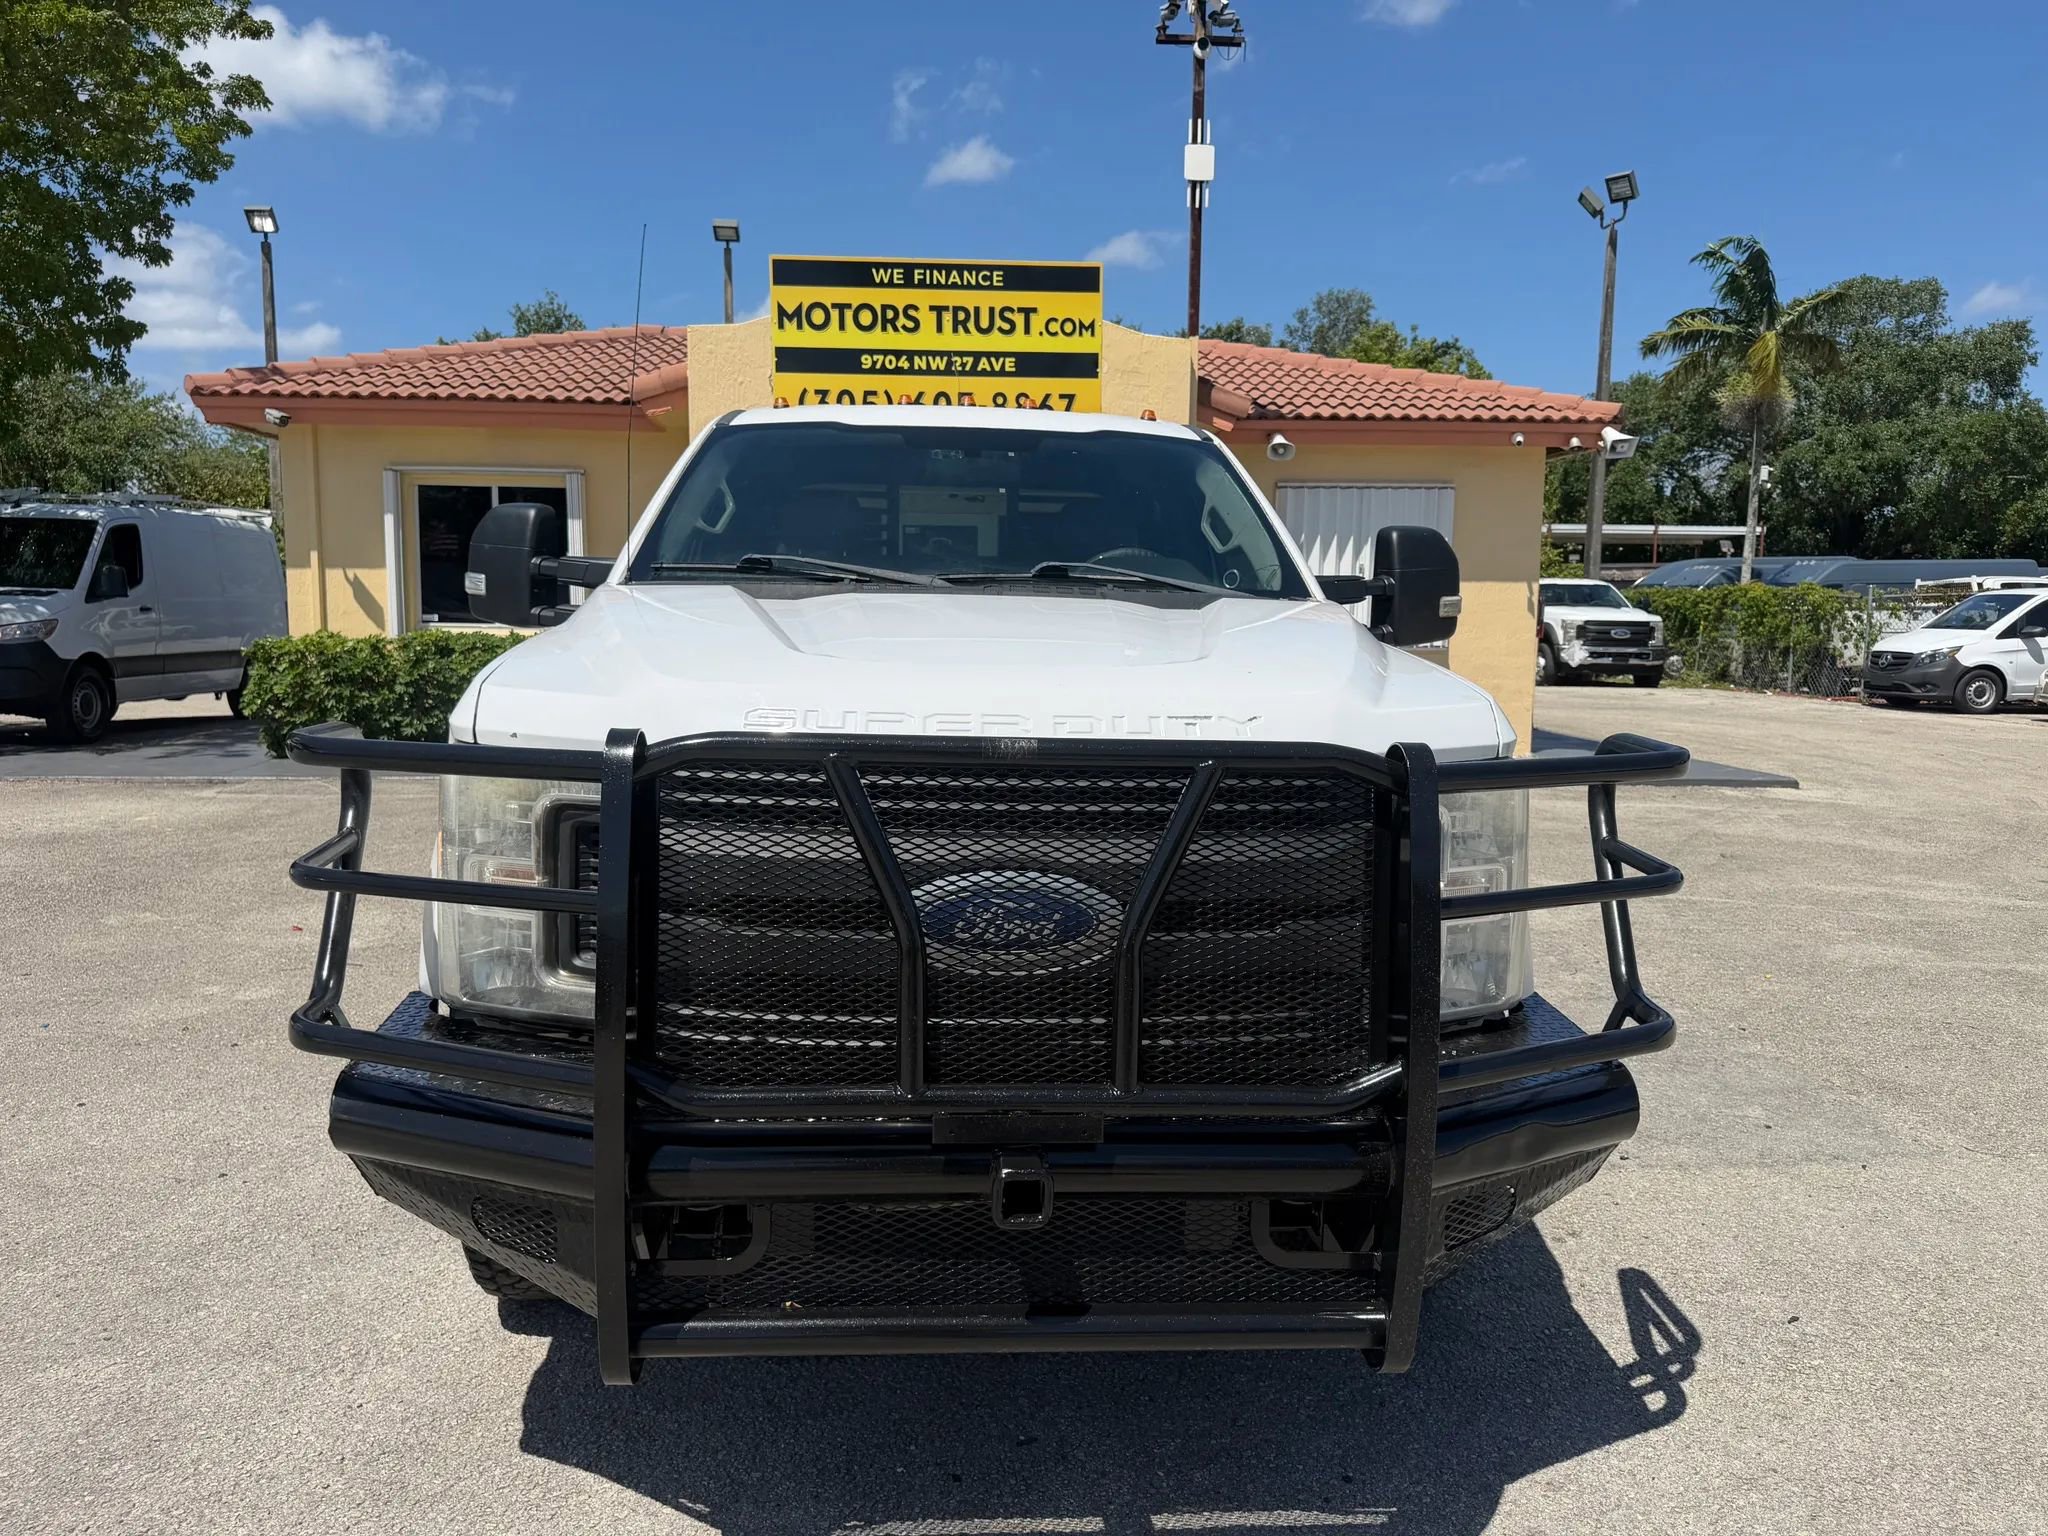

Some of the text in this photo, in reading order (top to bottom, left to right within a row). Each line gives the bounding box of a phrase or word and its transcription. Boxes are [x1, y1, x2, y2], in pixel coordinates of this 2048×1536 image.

[871, 267, 1004, 287] WE FINANCE
[776, 301, 921, 334] MOTORS
[860, 354, 1017, 372] 9704 NW 27 AVE
[743, 707, 1264, 737] SUPER DUTY
